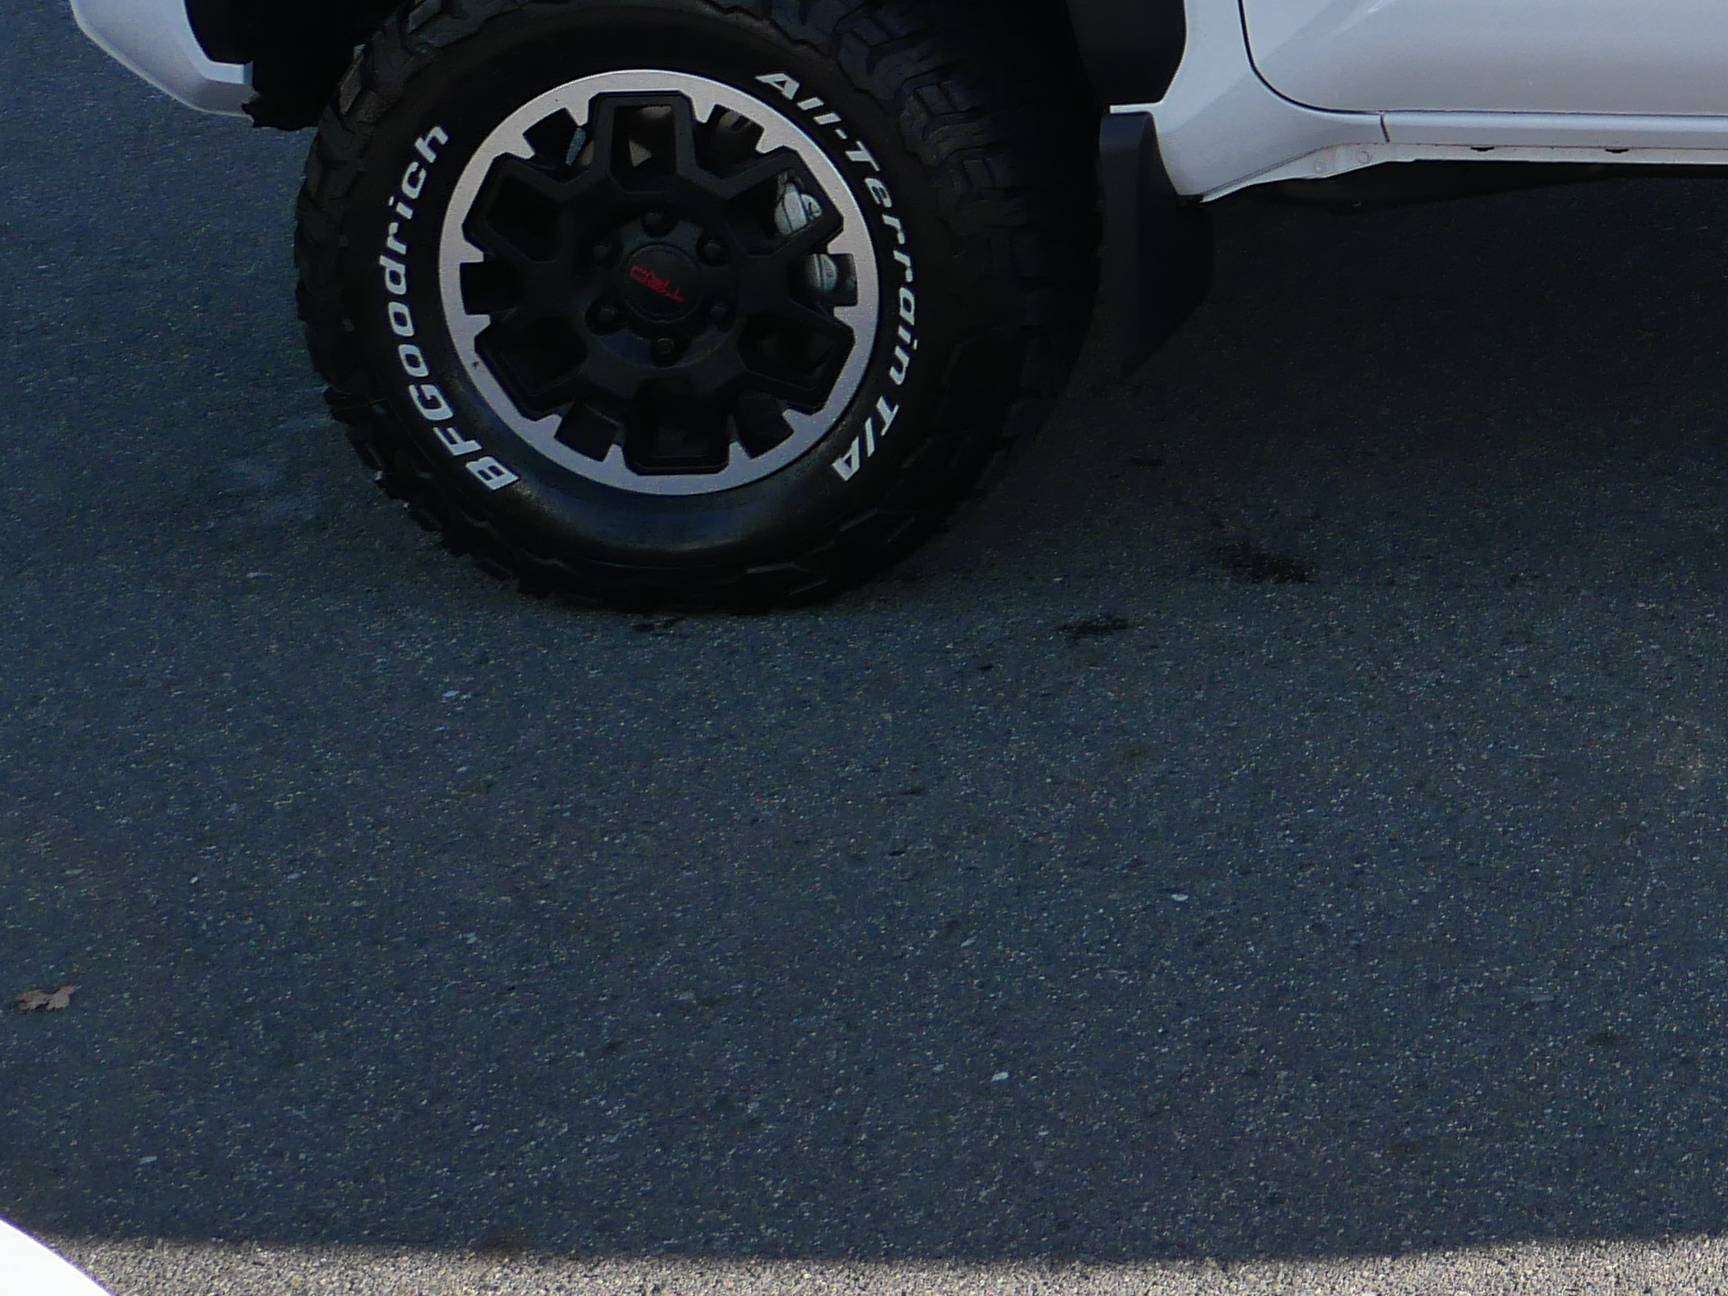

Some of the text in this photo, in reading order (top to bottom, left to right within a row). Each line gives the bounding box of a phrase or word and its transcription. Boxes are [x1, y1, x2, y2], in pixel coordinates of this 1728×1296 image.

[379, 124, 519, 492] BFGoodrich
[755, 71, 919, 483] All-Terrain T/A
